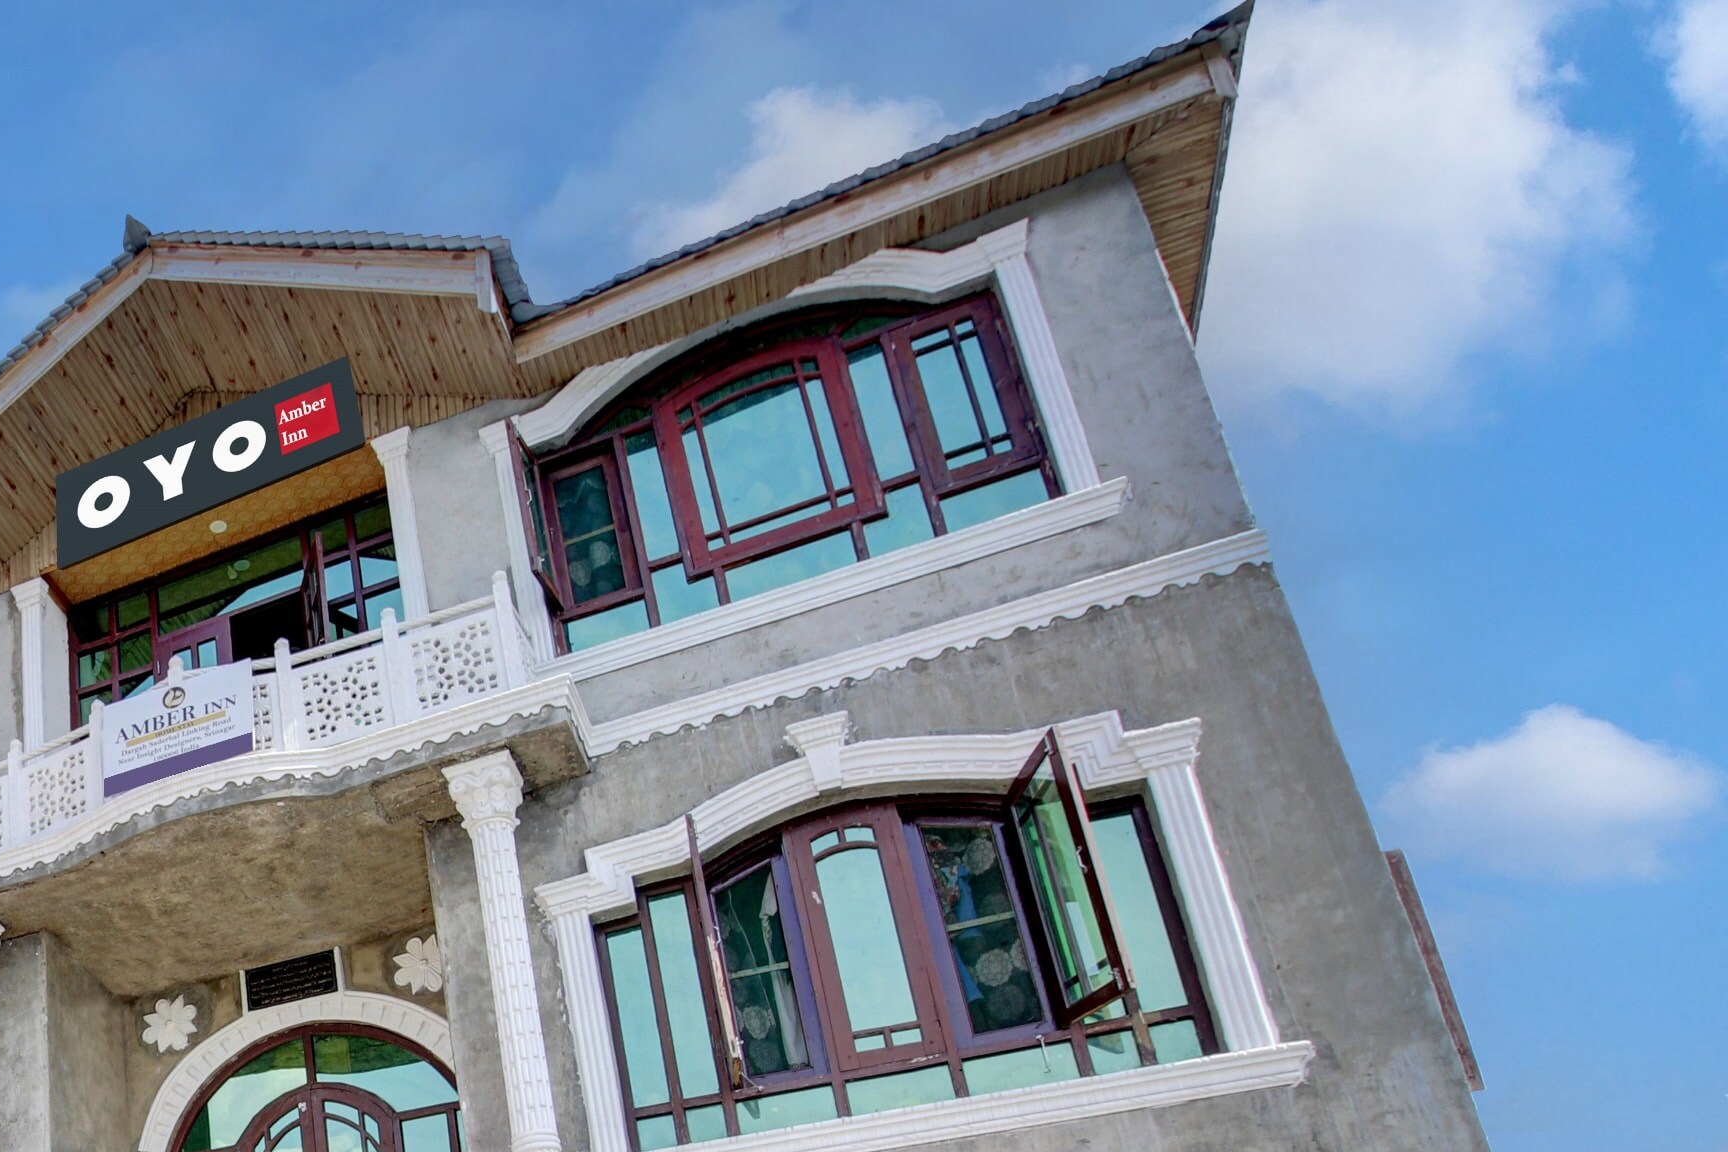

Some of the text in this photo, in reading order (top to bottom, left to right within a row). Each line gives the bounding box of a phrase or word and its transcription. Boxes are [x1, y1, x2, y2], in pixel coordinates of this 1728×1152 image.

[278, 396, 327, 425] Amber
[281, 427, 308, 447] Inn
[77, 420, 266, 529] OYO
[115, 694, 237, 744] AMBER INN
[182, 724, 210, 737] Linking
[212, 716, 232, 727] Road
[118, 754, 136, 765] Near
[137, 746, 162, 760] Insight
[204, 724, 236, 738] Srinagar
